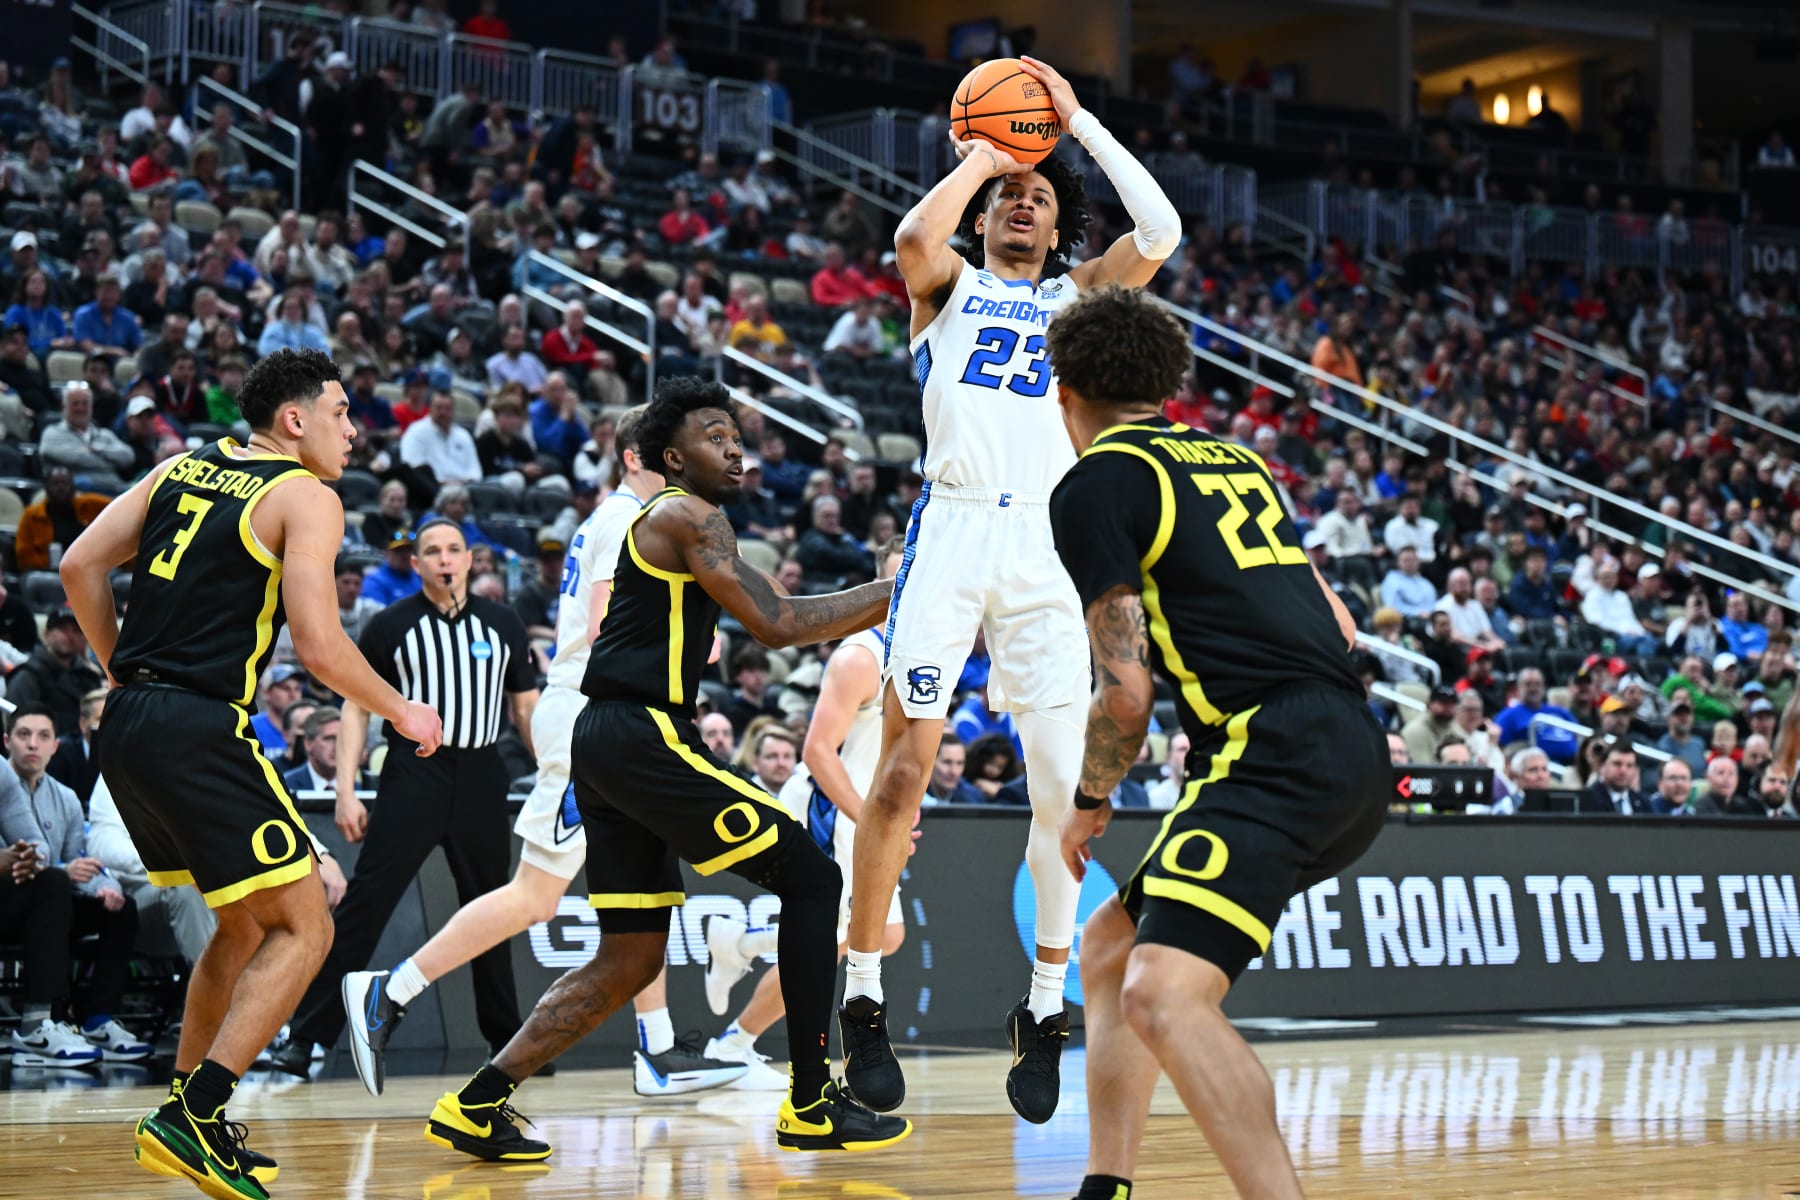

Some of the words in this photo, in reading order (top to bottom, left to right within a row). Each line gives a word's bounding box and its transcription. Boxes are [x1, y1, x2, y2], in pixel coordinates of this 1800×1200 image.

[642, 89, 699, 131] 103
[1751, 244, 1798, 275] 104
[961, 295, 1057, 328] CREIGHT
[958, 326, 1052, 398] 23
[1150, 436, 1248, 465] TRACEY
[168, 457, 264, 500] SHELSTAD
[148, 492, 215, 582] 3
[1190, 472, 1309, 570] 22
[251, 818, 297, 865] O
[713, 801, 760, 844] O
[1160, 828, 1230, 881] O
[1247, 876, 1352, 970] HE
[1356, 875, 1520, 968] ROAD
[1524, 874, 1604, 964] TO
[1606, 874, 1717, 962] THE
[1717, 874, 1800, 959] FIN
